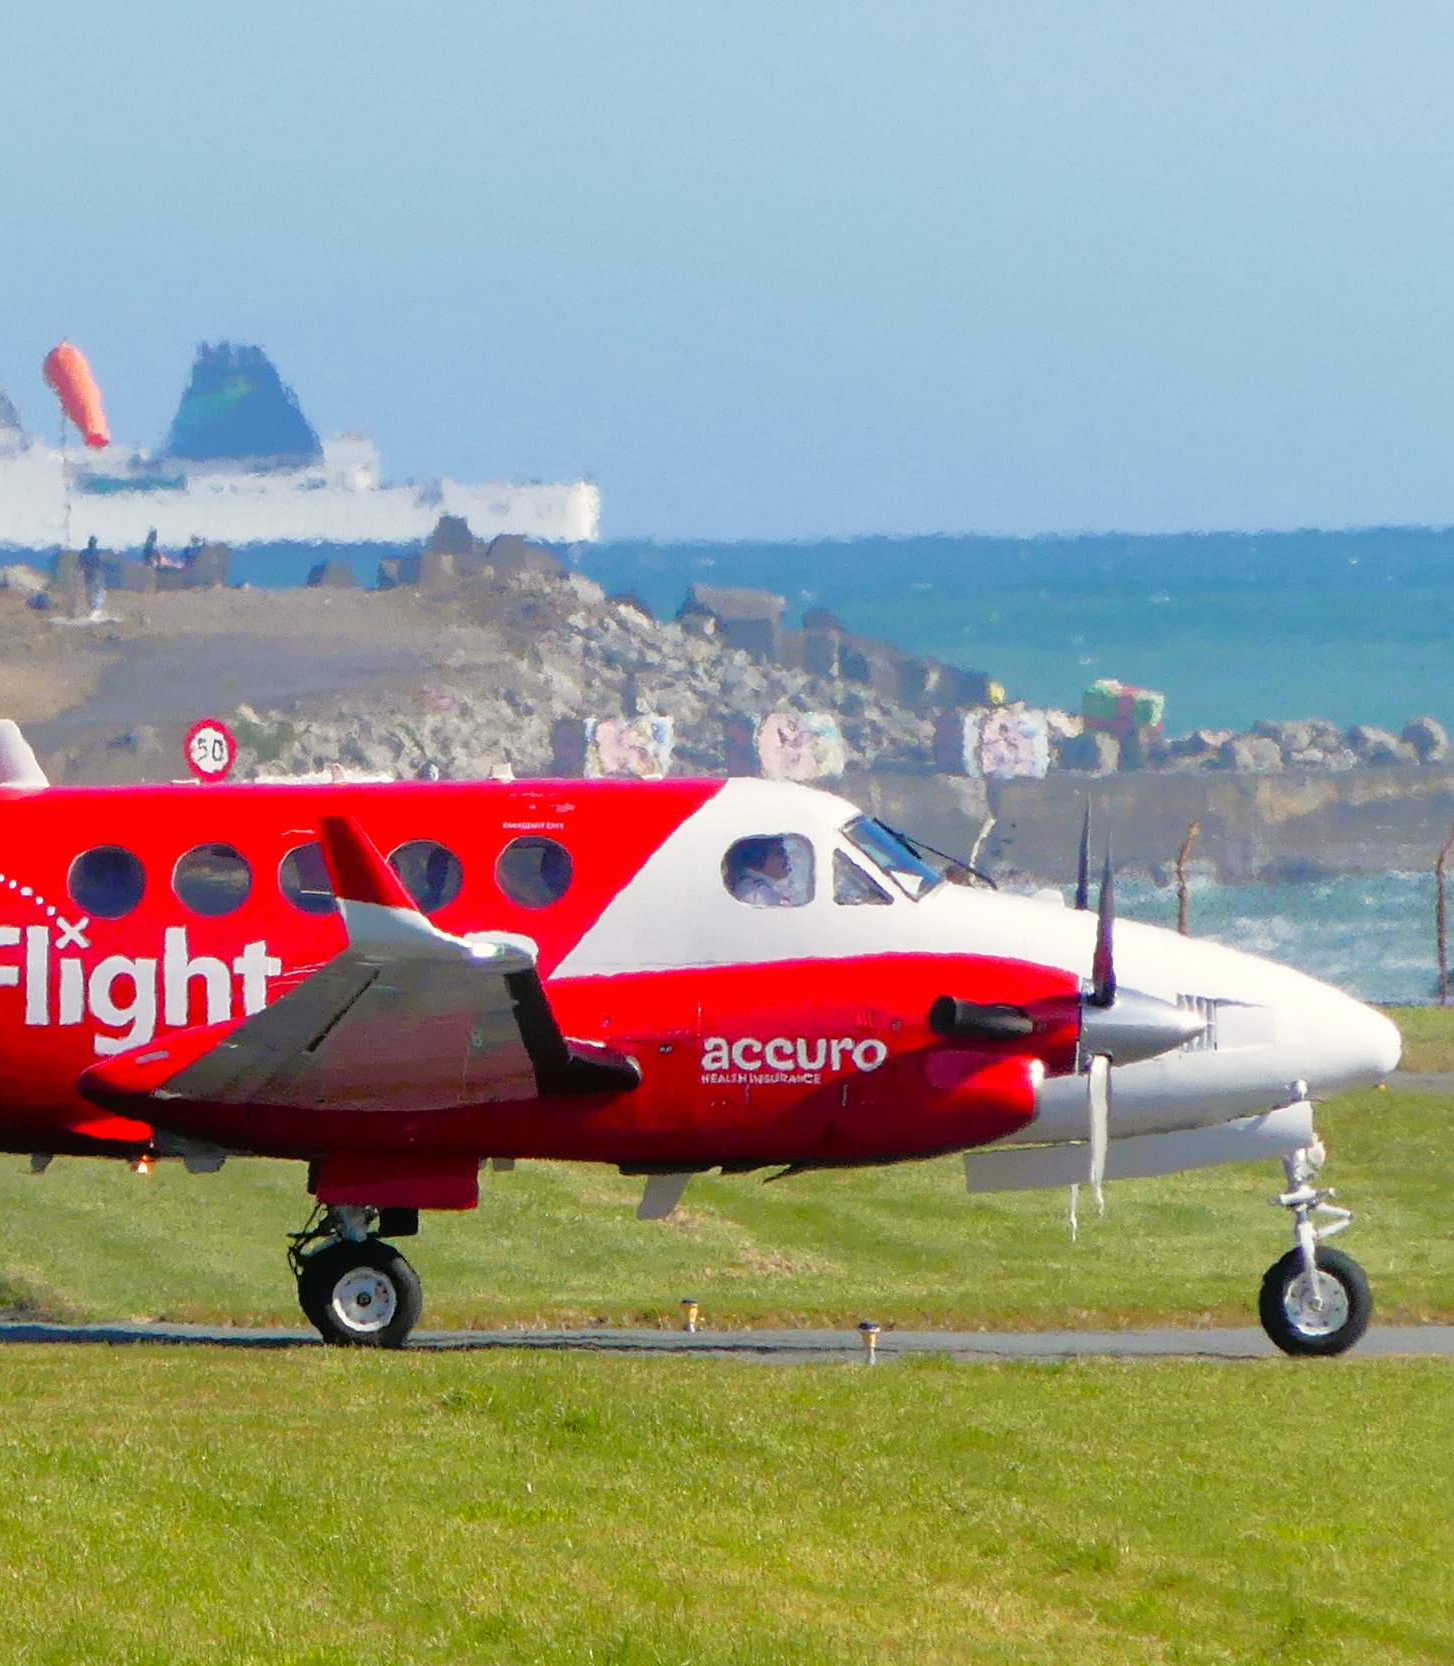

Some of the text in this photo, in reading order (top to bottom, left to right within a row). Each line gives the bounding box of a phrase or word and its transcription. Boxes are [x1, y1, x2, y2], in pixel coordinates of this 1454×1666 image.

[197, 737, 224, 761] 50
[701, 1037, 888, 1072] accuro
[701, 1073, 822, 1085] HEALTH INSURANCE
